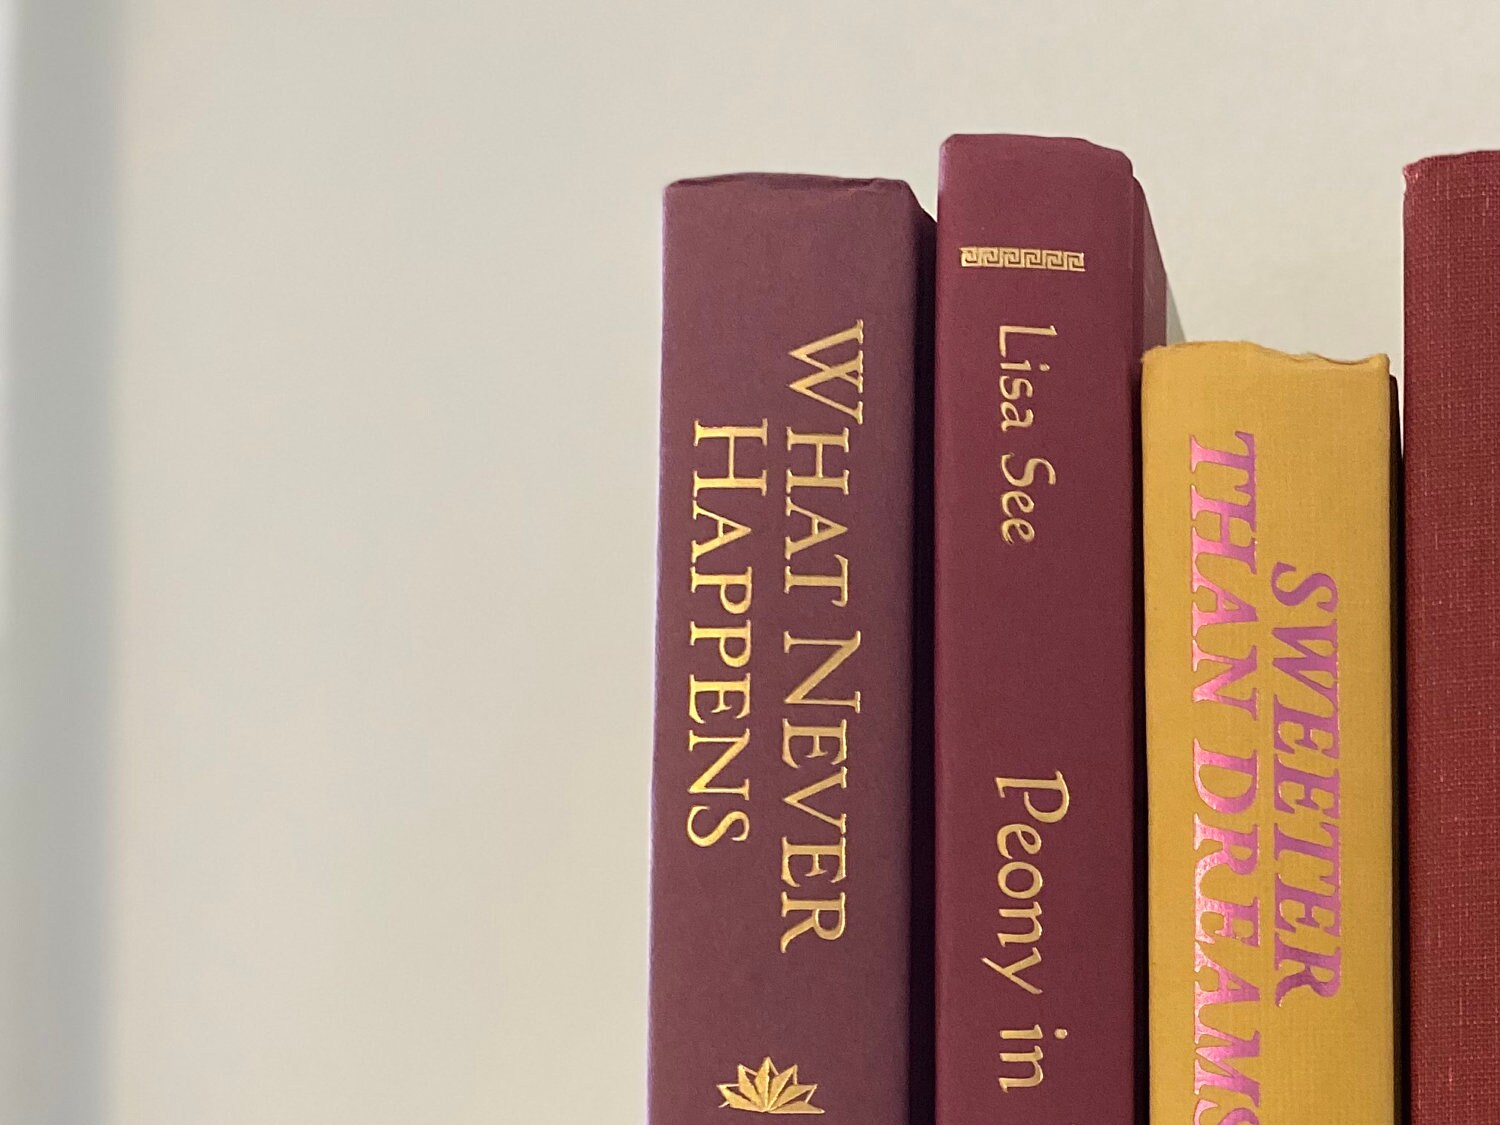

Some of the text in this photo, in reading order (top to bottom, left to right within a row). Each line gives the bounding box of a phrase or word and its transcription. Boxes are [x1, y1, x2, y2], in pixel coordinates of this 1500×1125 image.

[999, 325, 1057, 545] Lisa See
[1190, 431, 1258, 720] THAN
[687, 419, 768, 847] HAPPENS
[781, 320, 864, 953] WHAT NEVER
[982, 771, 1070, 994] Peony
[1270, 561, 1342, 1007] SWEETER
[999, 1024, 1068, 1092] in
